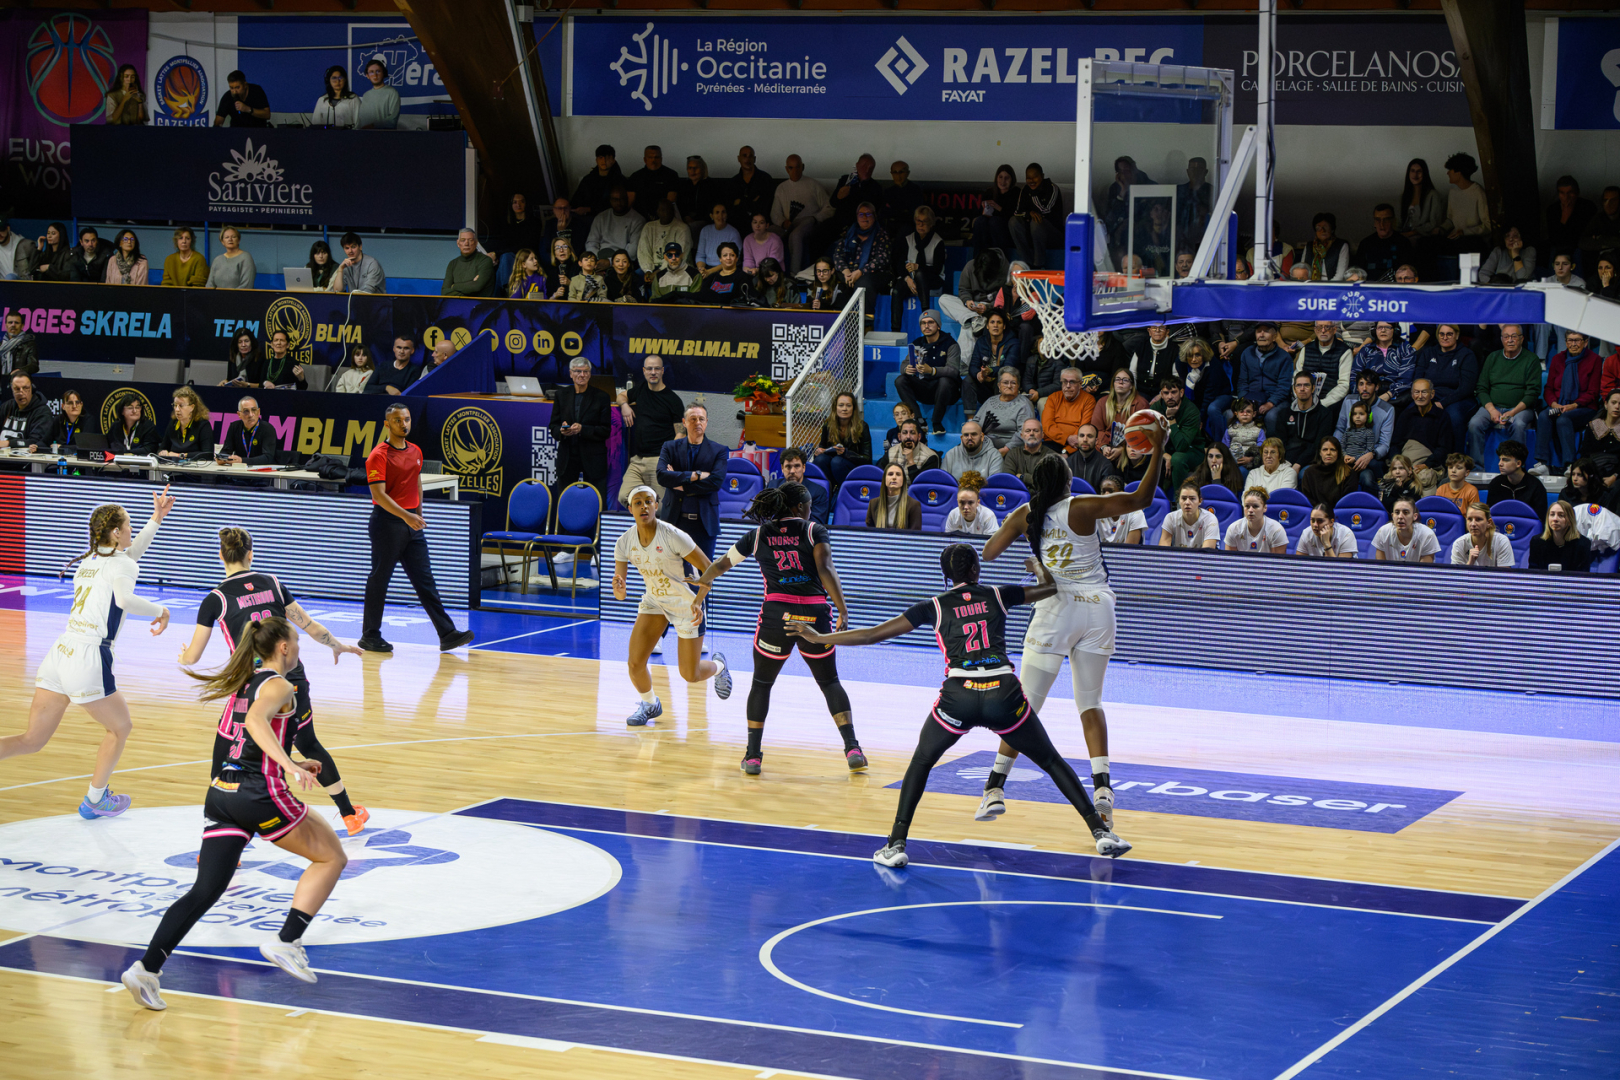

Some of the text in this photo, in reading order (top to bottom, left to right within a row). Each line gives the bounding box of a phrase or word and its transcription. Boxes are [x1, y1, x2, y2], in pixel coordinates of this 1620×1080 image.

[696, 38, 768, 55] La Région
[696, 55, 828, 80] Occitanie
[942, 47, 1077, 84] RAZEL
[696, 82, 827, 95] Pyrénées Méditerranée
[941, 90, 986, 103] FAYAT
[1240, 80, 1314, 92] CAELAGE
[1322, 80, 1358, 92] SALLE
[1360, 80, 1378, 92] DE
[1381, 80, 1418, 93] BAINS
[208, 205, 254, 214] PAYSAGISTE
[1297, 297, 1338, 311] SURE
[1341, 290, 1366, 319] SURE SHOT
[1367, 299, 1409, 313] SHOT
[80, 309, 172, 339] SKRELA
[315, 323, 363, 344] BLMA
[628, 337, 761, 359] WWW.BLMA.FR
[872, 347, 882, 360] B
[444, 416, 457, 436] LATTES
[456, 410, 491, 424] MONTPELLIER
[488, 423, 500, 461] ASSOCIATION
[773, 549, 804, 572] 20
[952, 600, 989, 619] TOURE
[962, 619, 992, 654] 21
